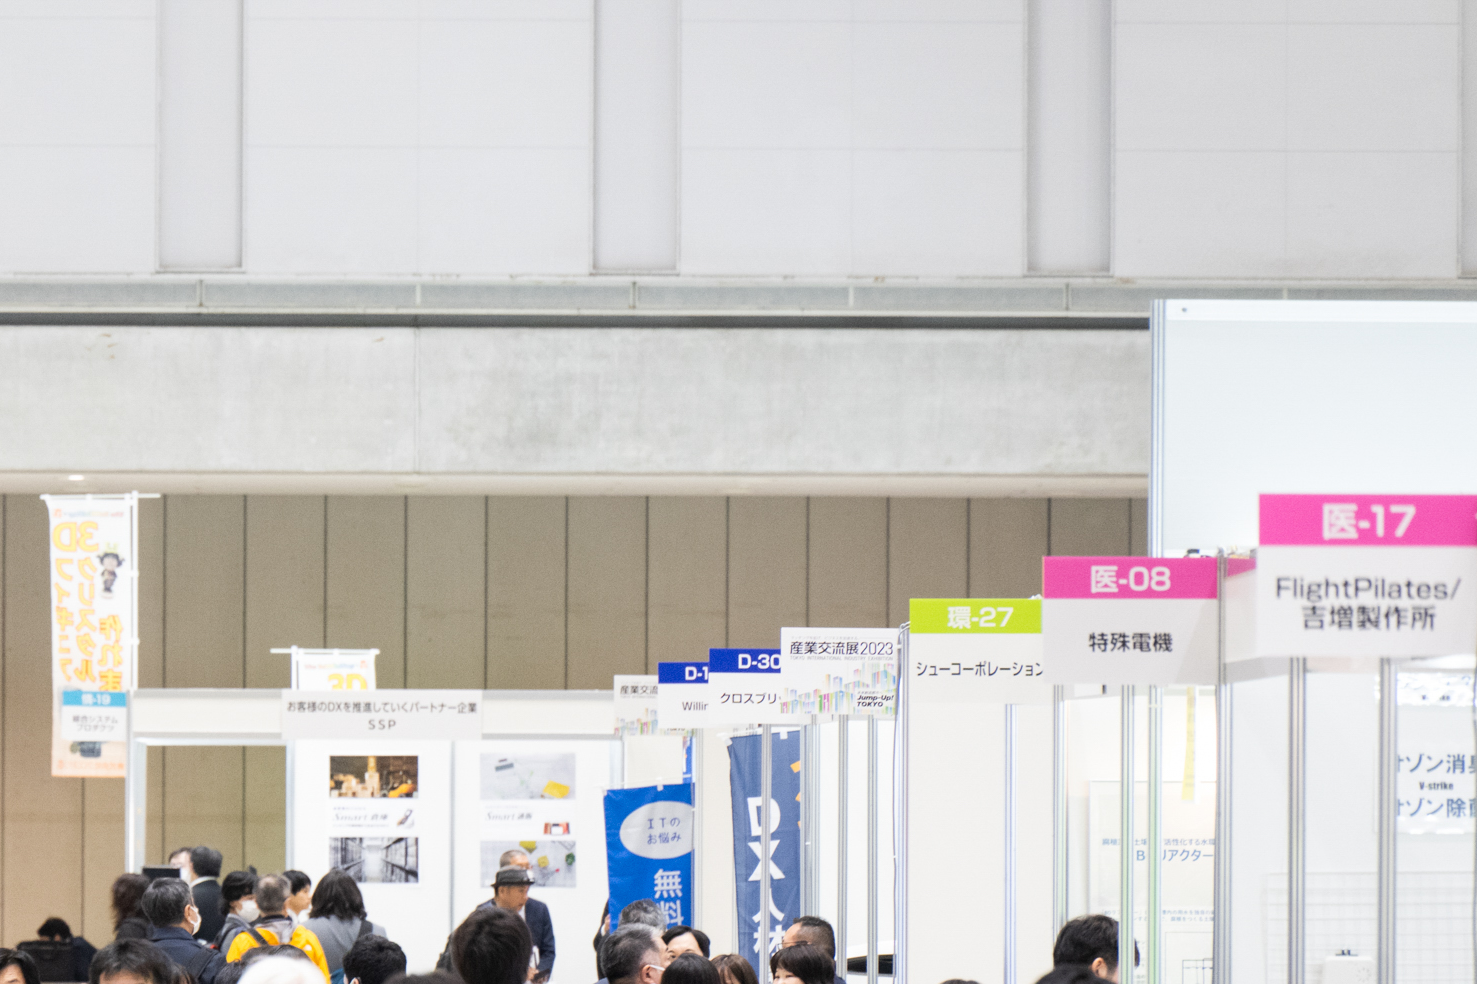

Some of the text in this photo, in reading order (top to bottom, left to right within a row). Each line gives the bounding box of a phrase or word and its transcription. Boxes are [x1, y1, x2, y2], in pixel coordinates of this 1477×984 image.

[1322, 503, 1416, 540] 医-17
[1090, 565, 1171, 593] 医-08
[1276, 576, 1462, 603] FlightPilates/
[947, 605, 1014, 629] 環-27
[1302, 605, 1437, 631] 吉増製作所
[790, 641, 893, 655] 産業交流展2023
[1089, 632, 1174, 653] 特殊電機
[720, 692, 781, 704] クロスブリ
[857, 694, 895, 702] Jump-Up!
[287, 701, 477, 714] お客様のDXを推進していくパートナー企業
[368, 719, 397, 730] SSP
[647, 831, 682, 845] お悩み
